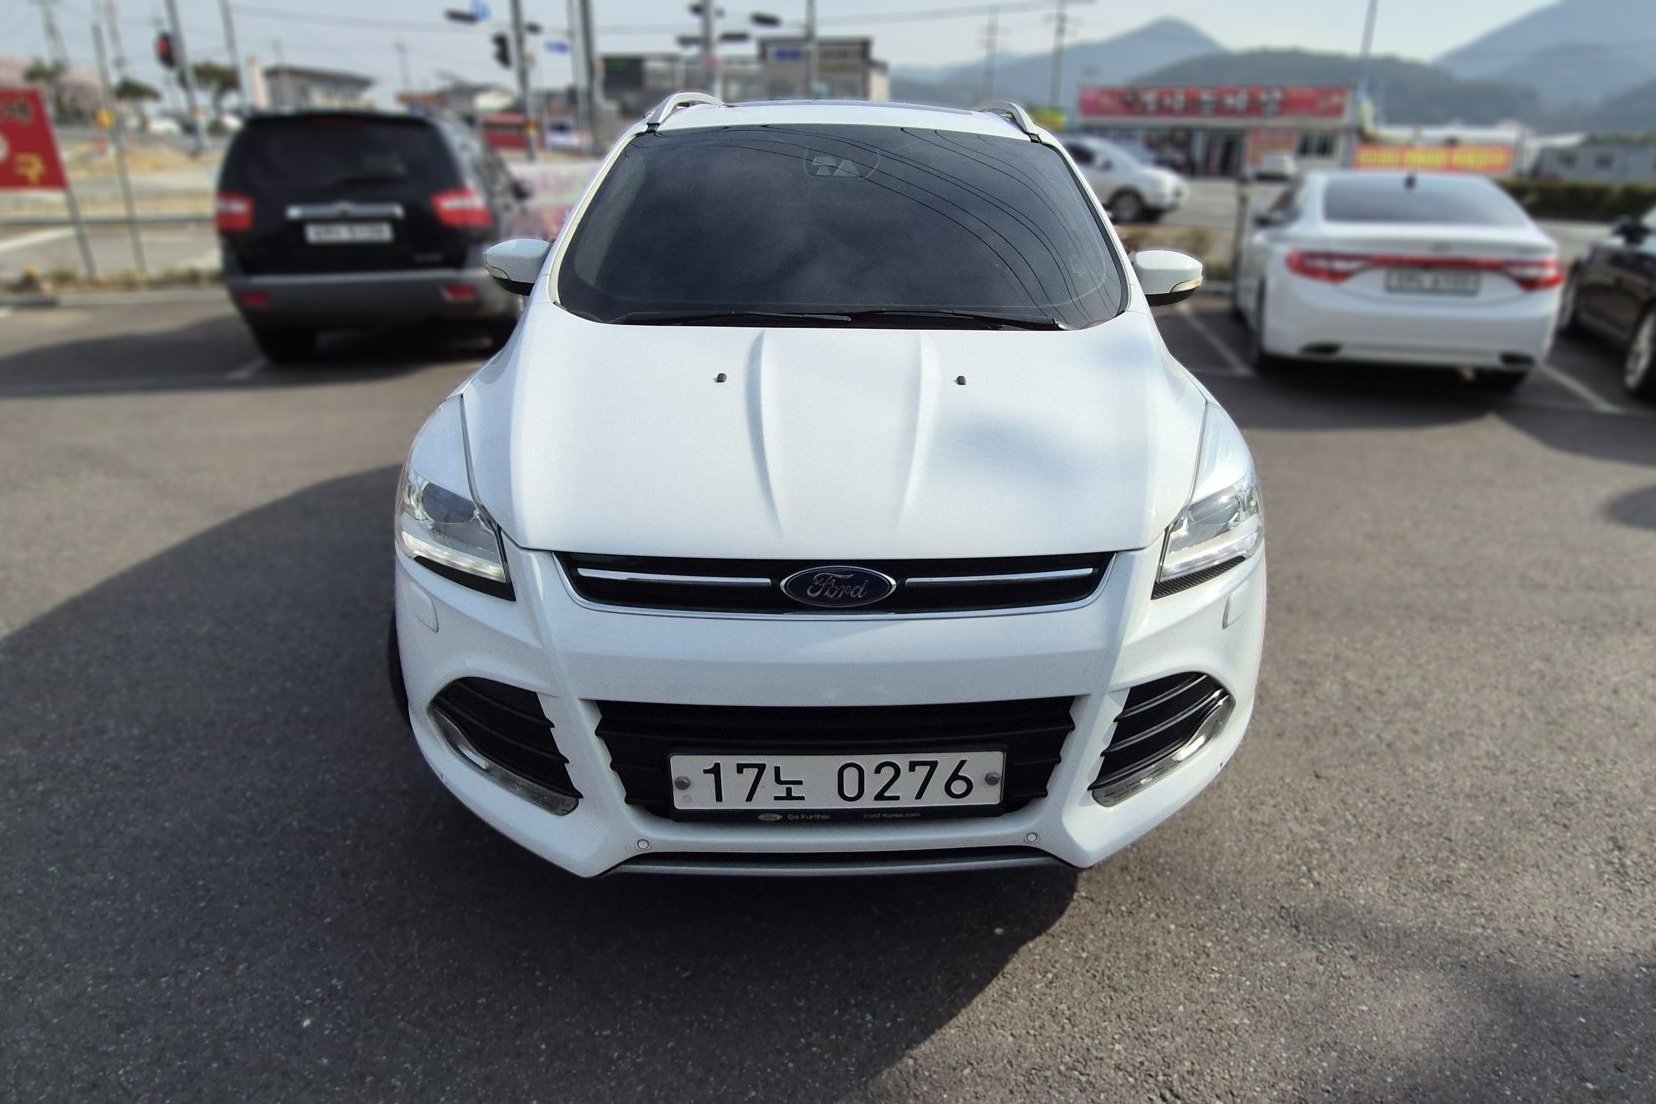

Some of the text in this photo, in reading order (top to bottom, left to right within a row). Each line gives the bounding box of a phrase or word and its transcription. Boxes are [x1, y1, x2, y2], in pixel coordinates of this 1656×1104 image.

[806, 572, 868, 599] Ford
[703, 759, 975, 803] 17노 0276
[787, 813, 800, 821] Go
[800, 813, 831, 821] Further
